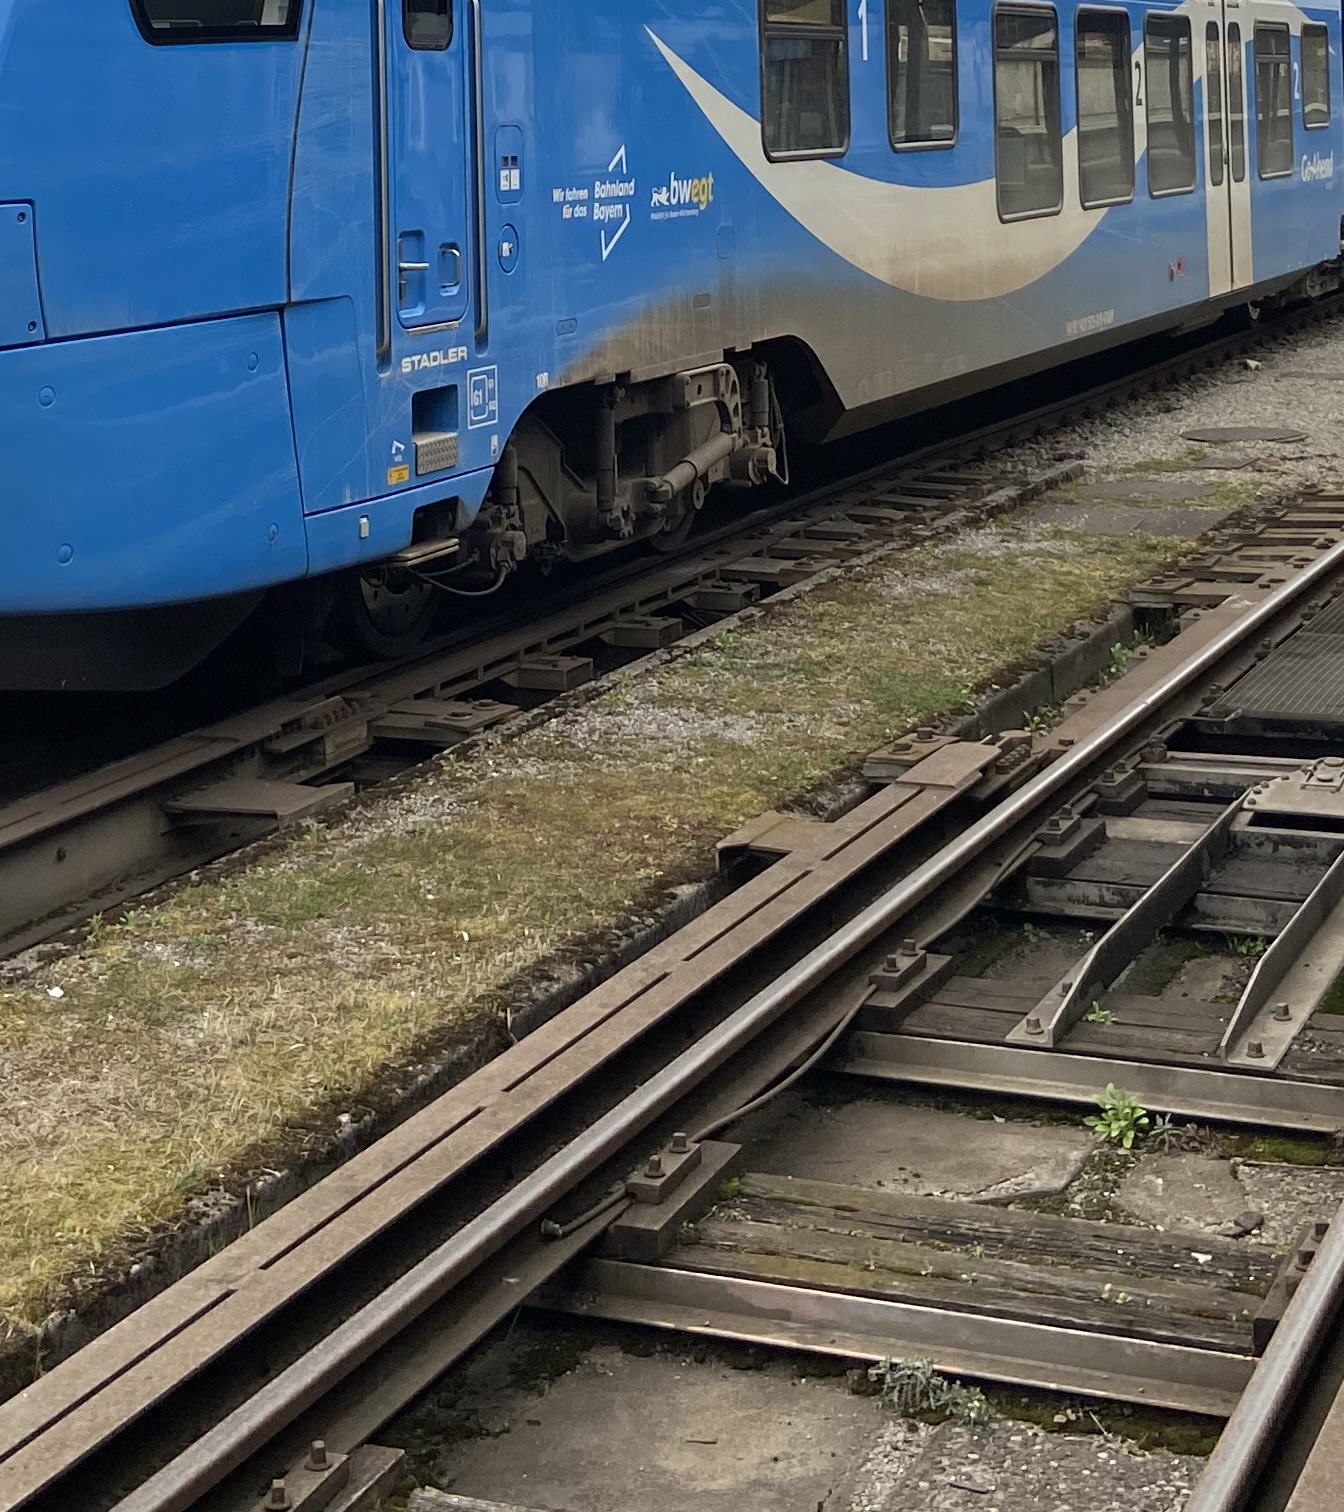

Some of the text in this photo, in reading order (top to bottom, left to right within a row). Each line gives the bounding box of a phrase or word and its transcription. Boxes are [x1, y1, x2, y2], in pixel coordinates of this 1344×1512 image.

[1135, 60, 1143, 107] 2
[1293, 61, 1300, 100] 2
[552, 187, 589, 203] Wir fahren
[594, 177, 635, 199] Bahnland
[670, 171, 715, 211] bwegt
[562, 203, 588, 219] für das
[593, 202, 623, 223] Bayern
[401, 345, 468, 374] STADLER
